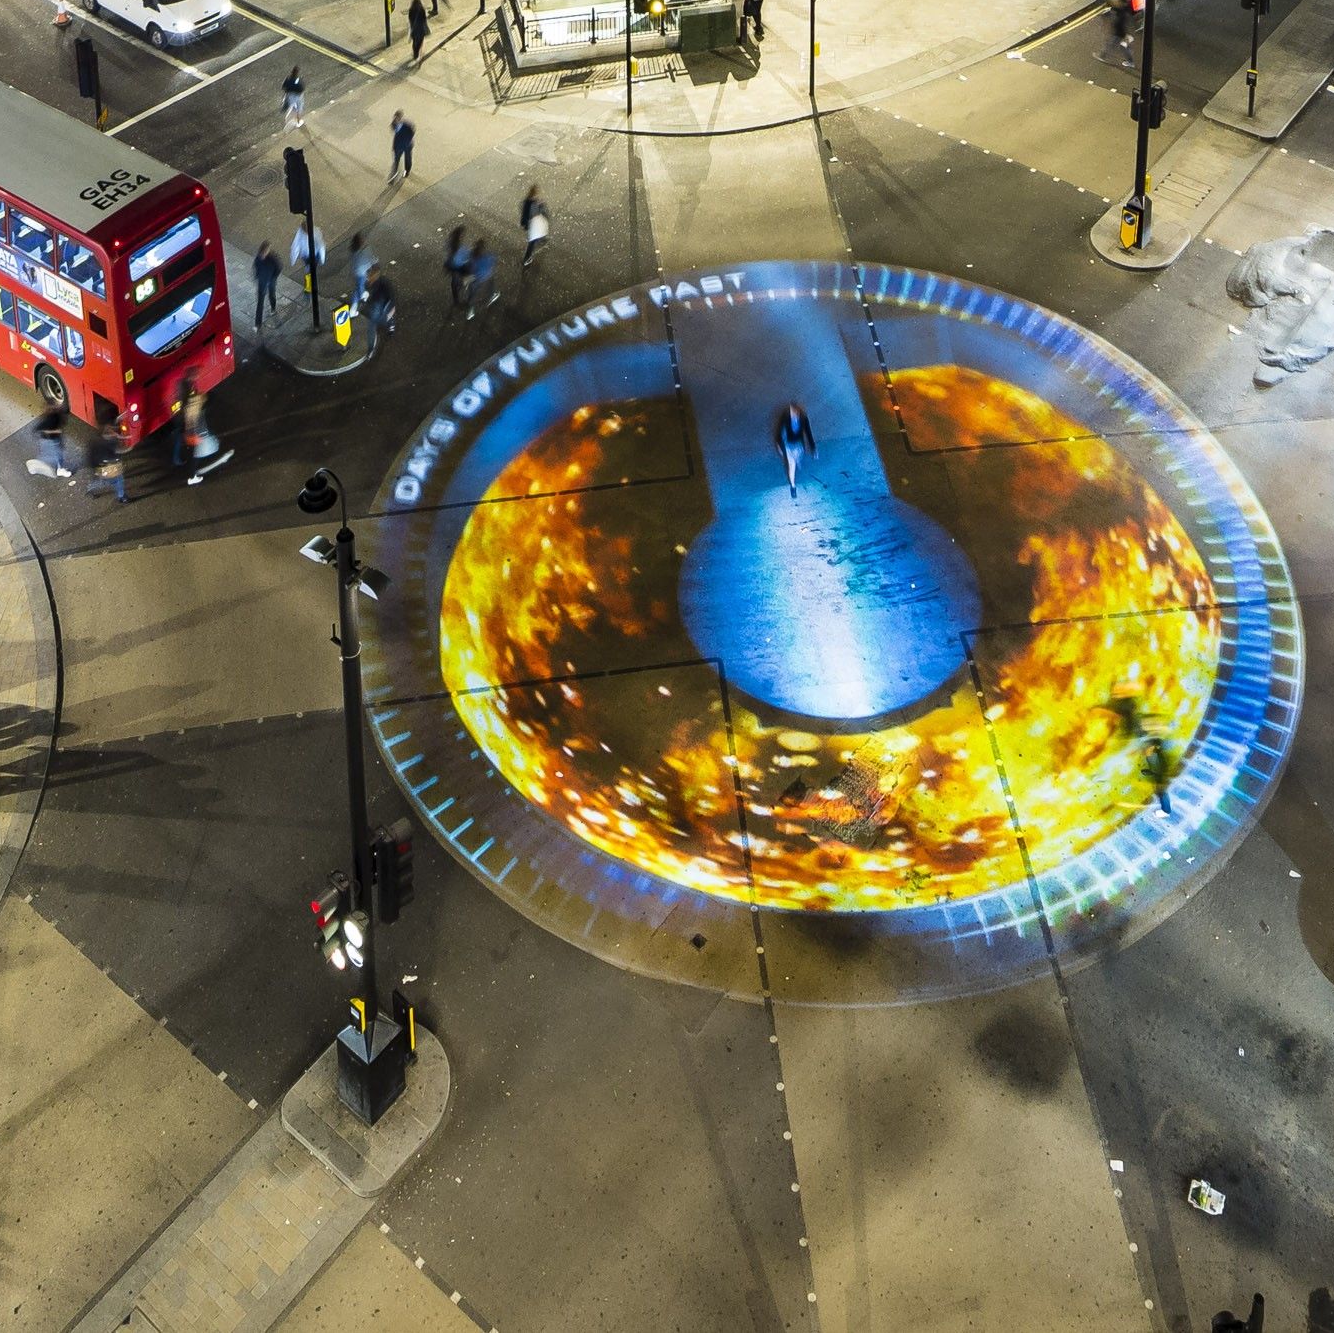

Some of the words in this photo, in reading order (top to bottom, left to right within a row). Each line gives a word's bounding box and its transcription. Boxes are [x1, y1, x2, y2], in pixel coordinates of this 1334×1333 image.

[79, 168, 132, 202] GAG
[91, 173, 151, 211] EH34
[57, 281, 79, 302] Lyca
[649, 271, 747, 307] PAST
[394, 414, 460, 507] DAYS
[451, 369, 497, 420] OF
[498, 294, 641, 380] FUTURE
